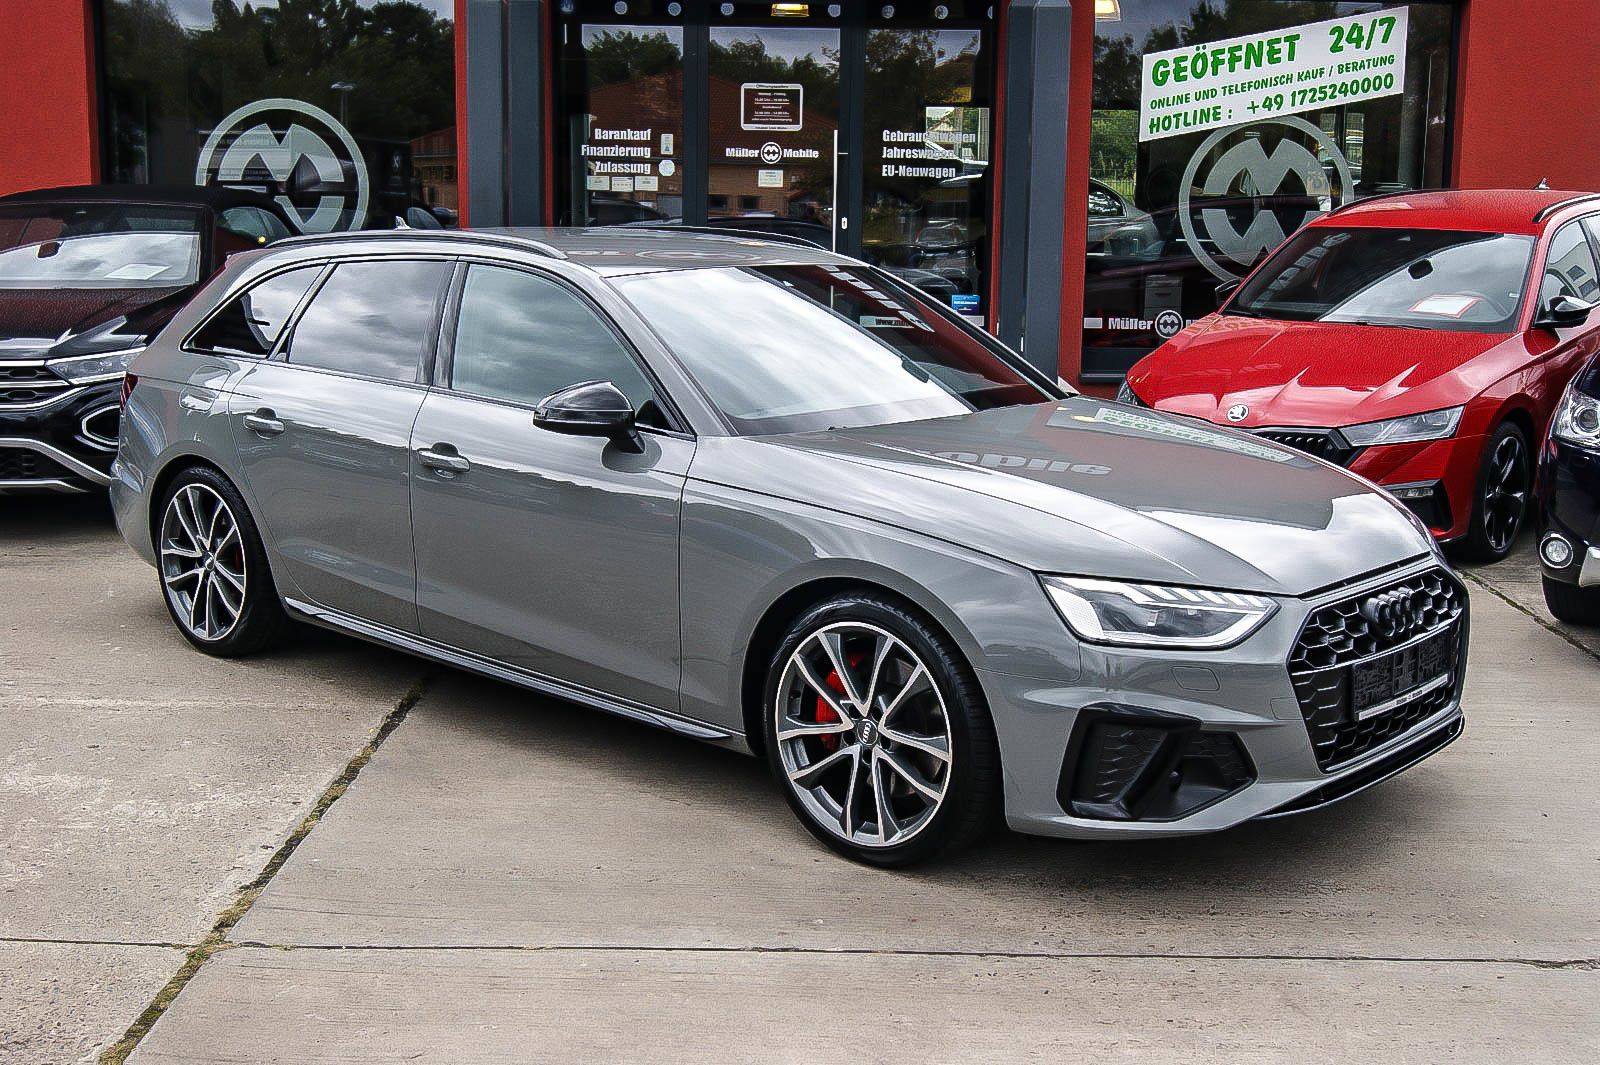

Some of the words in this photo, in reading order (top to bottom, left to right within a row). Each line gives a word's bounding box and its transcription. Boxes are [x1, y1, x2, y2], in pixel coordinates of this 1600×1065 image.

[1152, 34, 1300, 86] GEÖFFNET
[1329, 16, 1396, 53] 24/7
[1150, 92, 1191, 109] ONLINE
[1194, 88, 1218, 102] UND
[1221, 74, 1293, 96] TELEFONISCH
[1297, 67, 1325, 82] KAUF
[1337, 55, 1395, 74] BERATUNG
[1149, 105, 1222, 134] HOTLINE
[1247, 94, 1284, 114] +49
[1291, 73, 1394, 107] 1725240000
[595, 128, 652, 140] Barankauf
[581, 144, 652, 158] Finanzierung
[725, 148, 760, 157] Müller
[783, 149, 819, 158] Mobile
[594, 161, 651, 174] Zulassung
[882, 164, 956, 178] EU-Neuwagen
[1108, 317, 1153, 330] Müller
